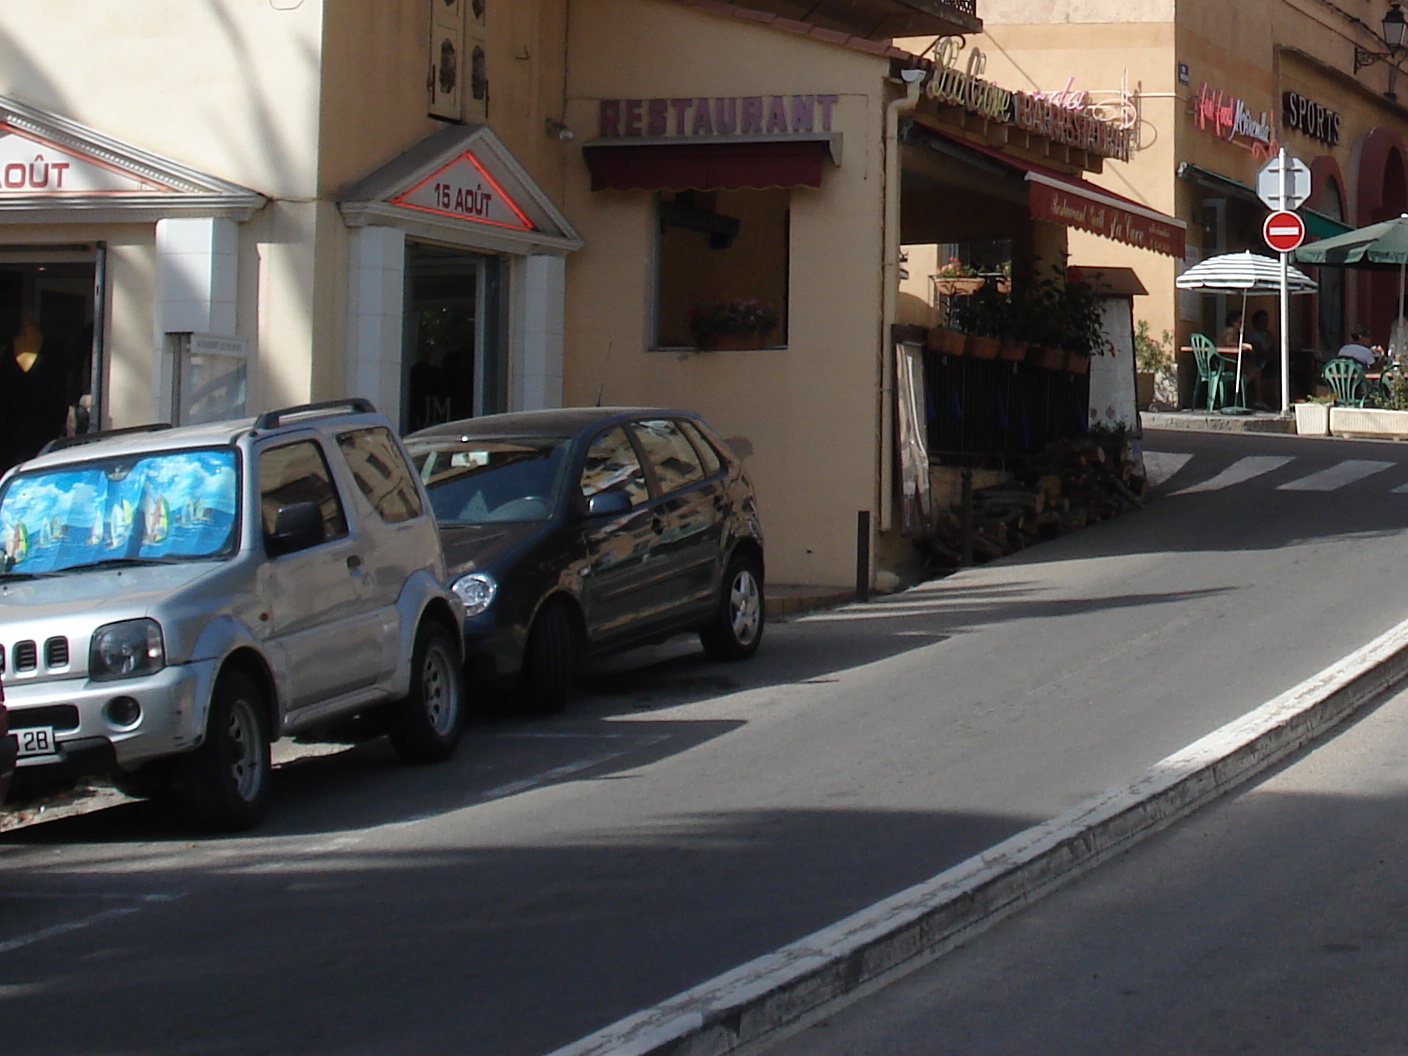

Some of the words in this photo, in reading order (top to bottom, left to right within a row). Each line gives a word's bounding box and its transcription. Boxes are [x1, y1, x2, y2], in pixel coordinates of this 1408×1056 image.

[600, 94, 839, 137] RESTAURANT
[1287, 92, 1341, 145] SPORTS
[0, 154, 70, 189] OÛT
[434, 183, 451, 209] 15
[454, 184, 492, 217] AOÛT
